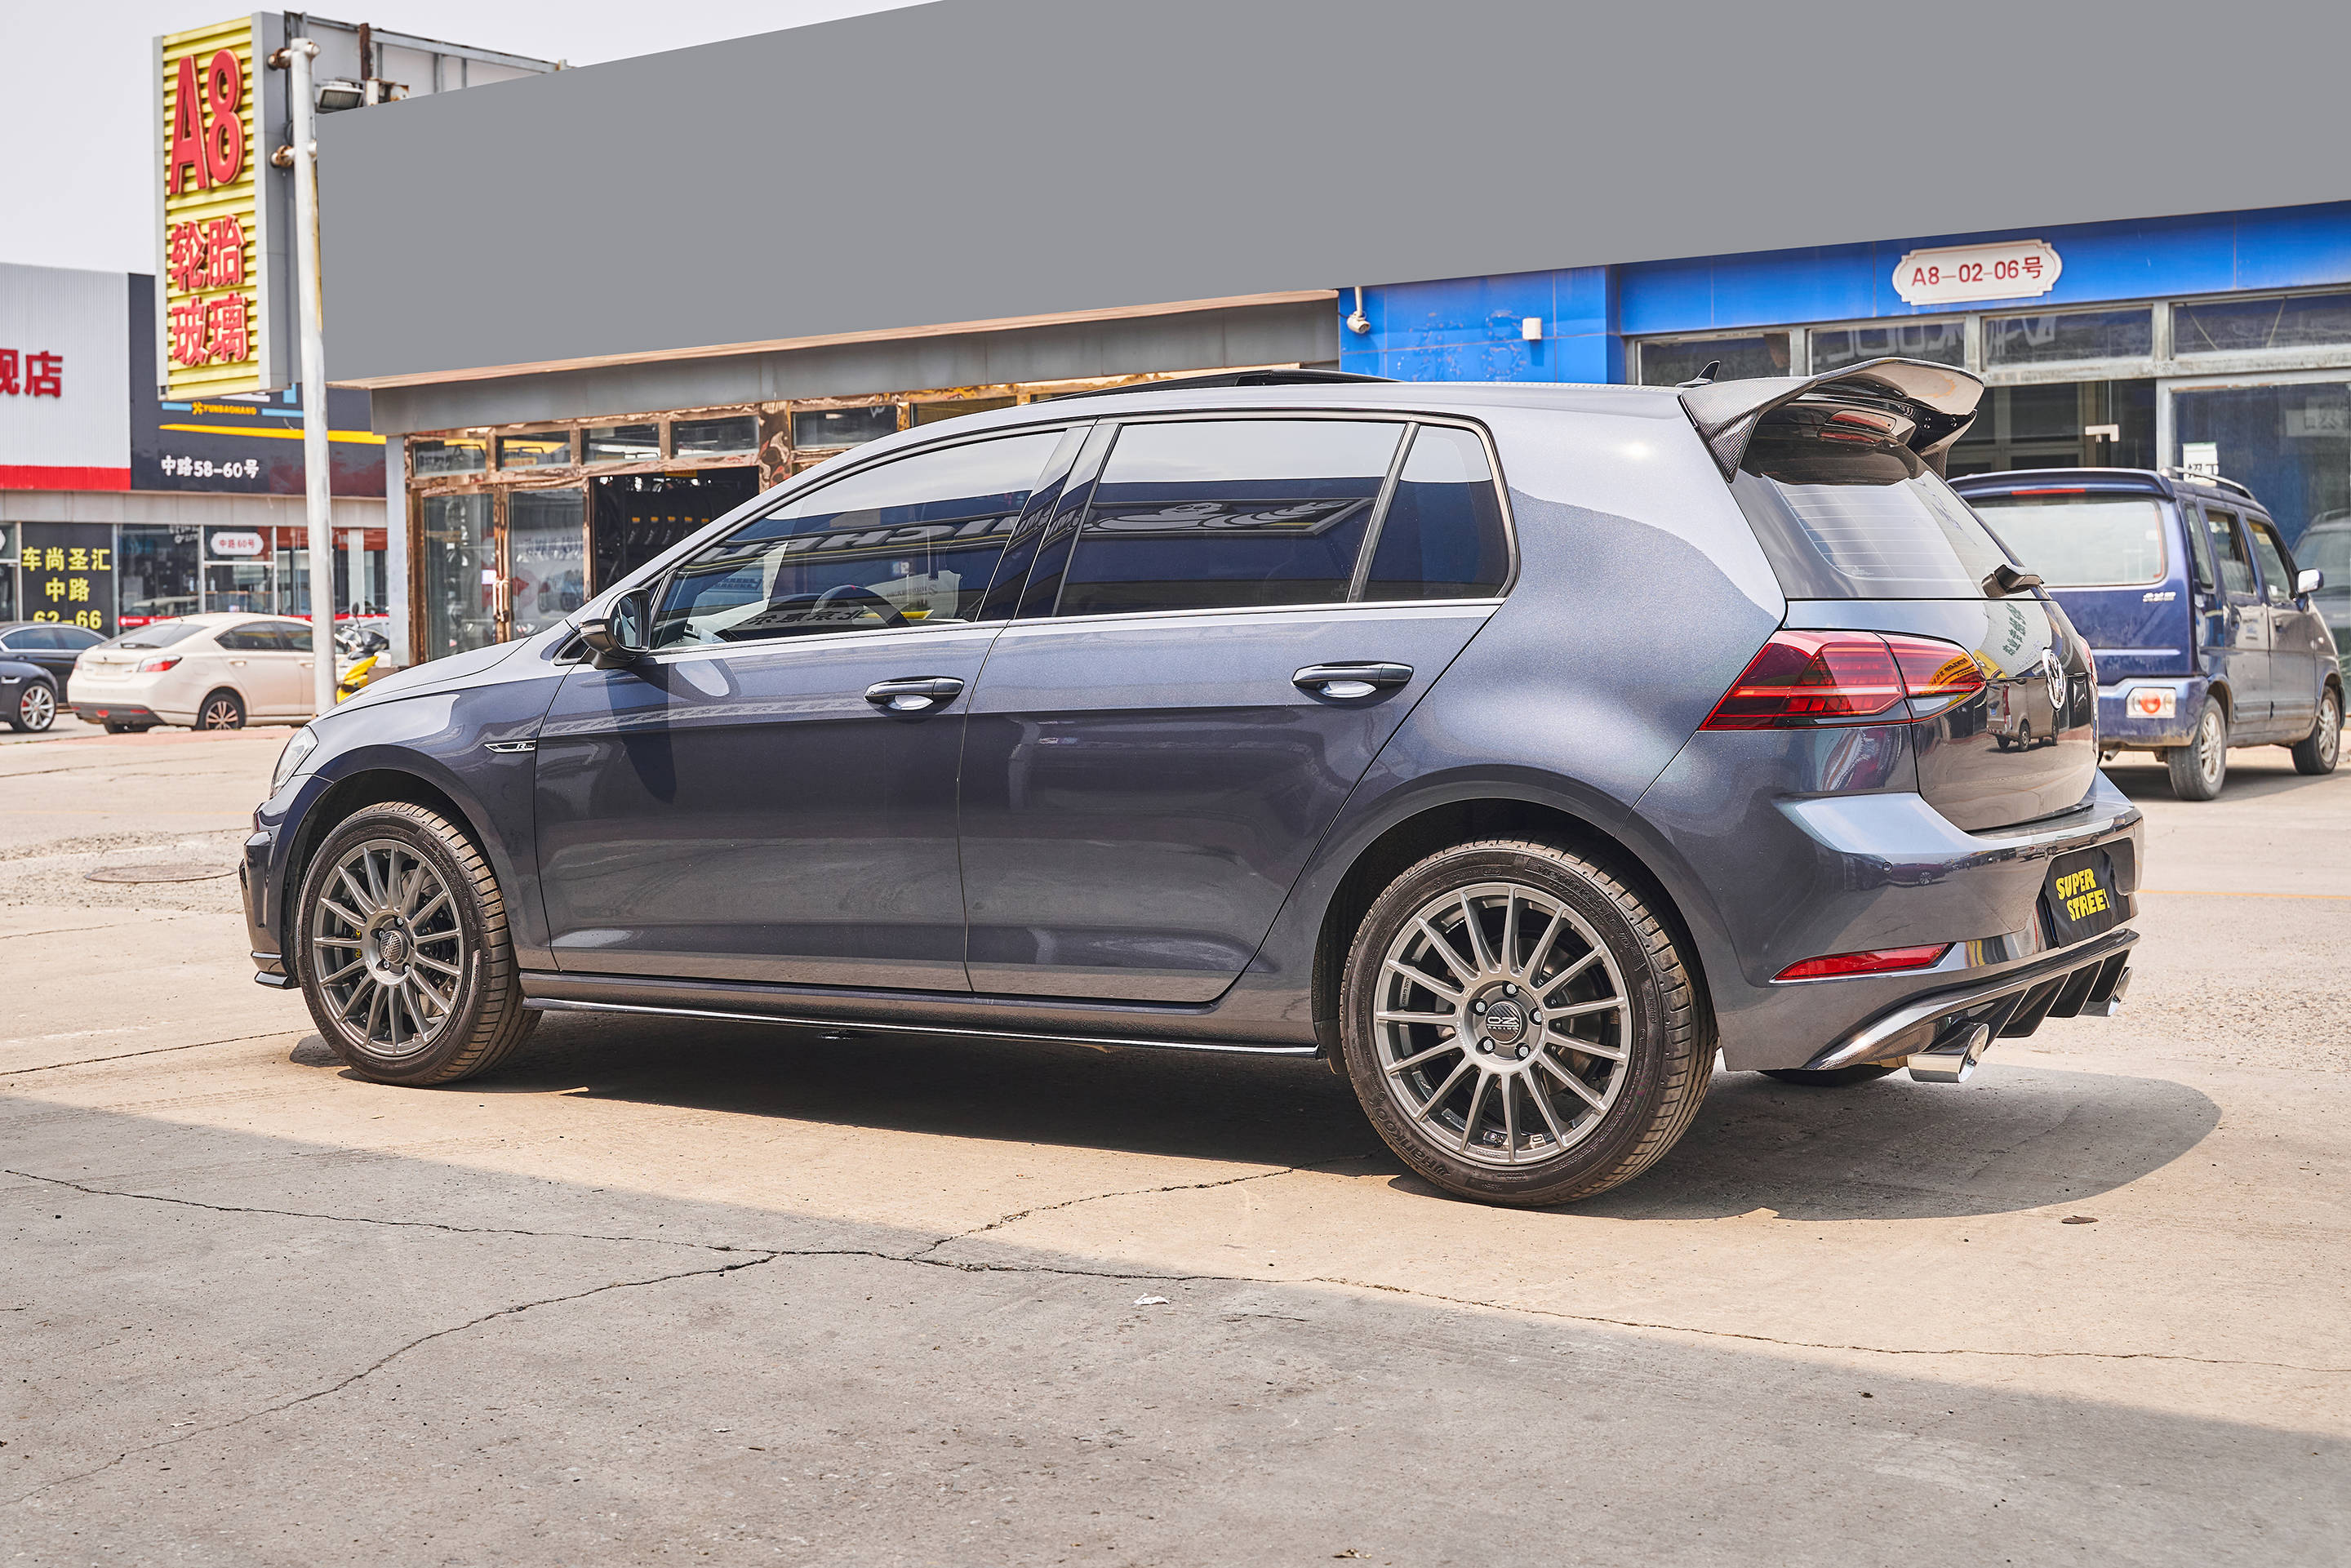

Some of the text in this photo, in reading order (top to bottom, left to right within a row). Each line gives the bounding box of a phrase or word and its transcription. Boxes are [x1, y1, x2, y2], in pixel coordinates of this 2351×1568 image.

[170, 48, 245, 194] A8
[170, 214, 247, 292] 轮胎
[171, 291, 249, 367] 玻璃
[161, 454, 260, 480] 中路58-60号
[21, 546, 112, 572] 车尚圣汇
[45, 576, 91, 603] 中路
[2055, 868, 2096, 899] SUPER
